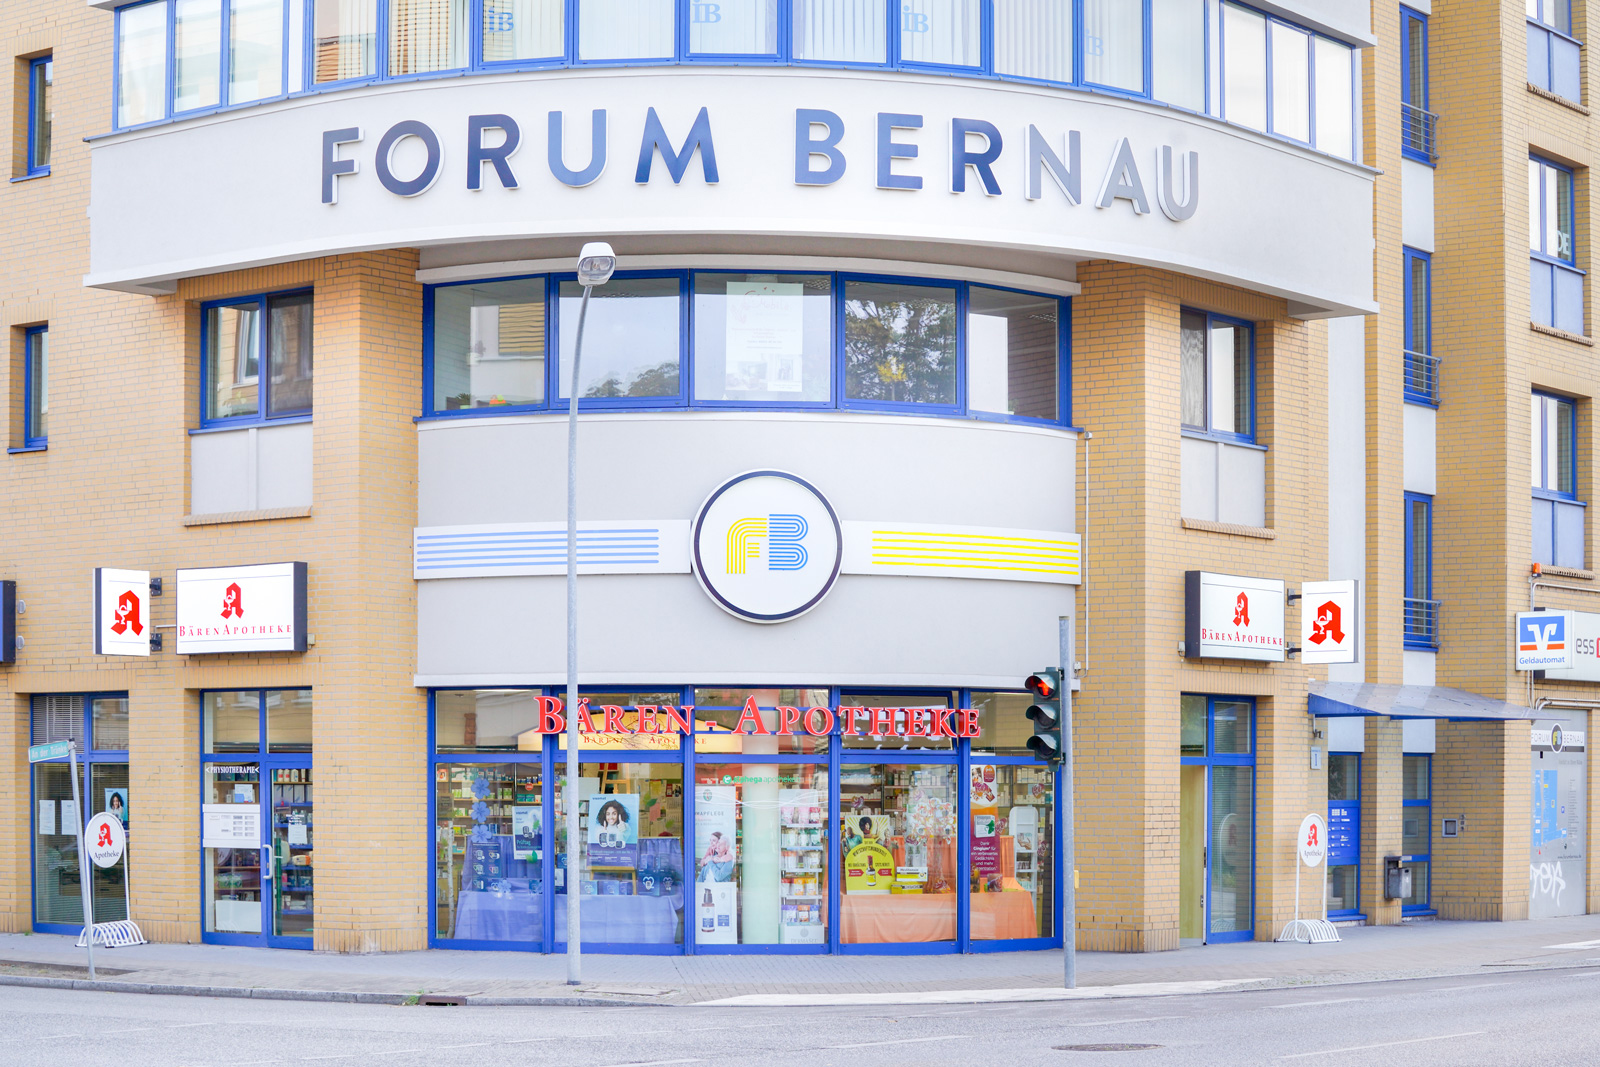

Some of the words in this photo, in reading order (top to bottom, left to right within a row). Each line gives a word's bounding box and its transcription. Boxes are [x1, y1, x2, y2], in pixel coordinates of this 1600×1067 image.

[321, 105, 720, 206] FORUM
[793, 107, 1199, 222] BERNAU
[726, 513, 809, 575] FB
[1576, 638, 1600, 657] ess
[1519, 656, 1565, 665] Geldautomat
[731, 695, 981, 738] APOTHEKE
[1530, 732, 1550, 743] FORUM
[1563, 733, 1584, 744] BERNAU
[93, 850, 120, 861] Apotheke
[1304, 849, 1322, 858] Apotheke
